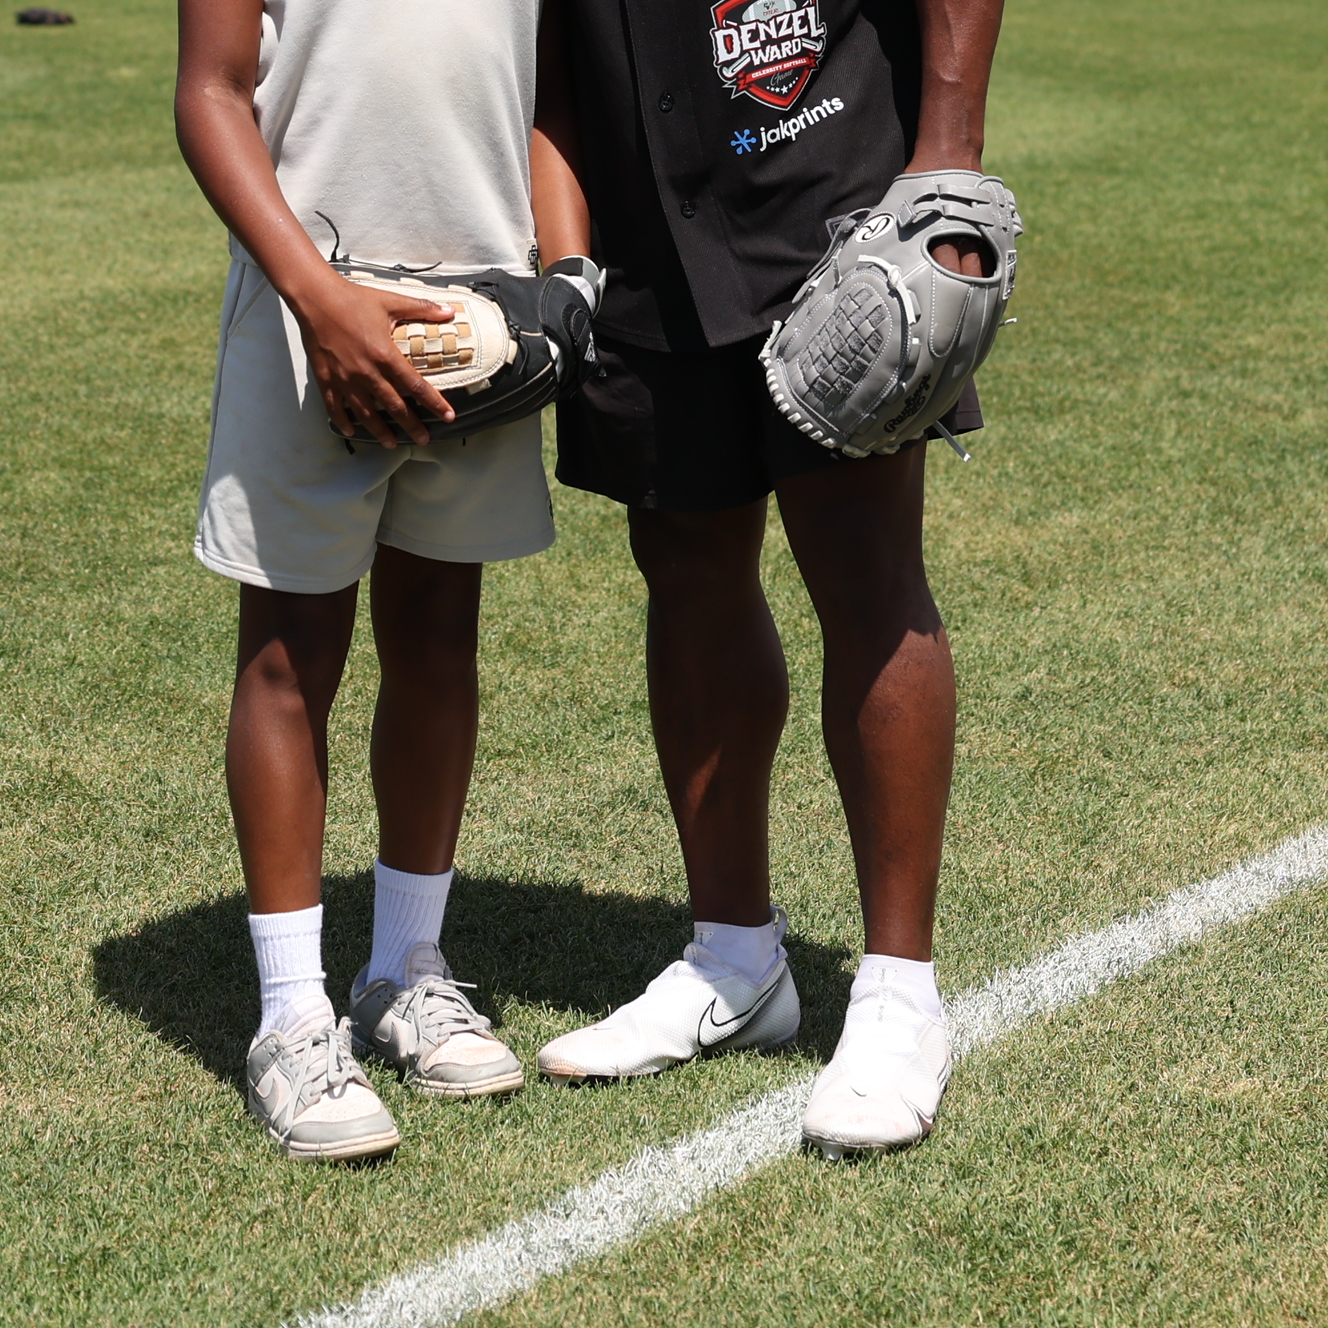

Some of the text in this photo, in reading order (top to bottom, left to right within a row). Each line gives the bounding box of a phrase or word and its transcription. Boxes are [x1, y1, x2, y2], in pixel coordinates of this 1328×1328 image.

[713, 5, 825, 65] DENZEL
[749, 37, 803, 67] WARD
[751, 58, 808, 79] CELEBRITY SOFTBALL
[758, 96, 845, 152] jakprints
[883, 374, 932, 433] Rawlings
